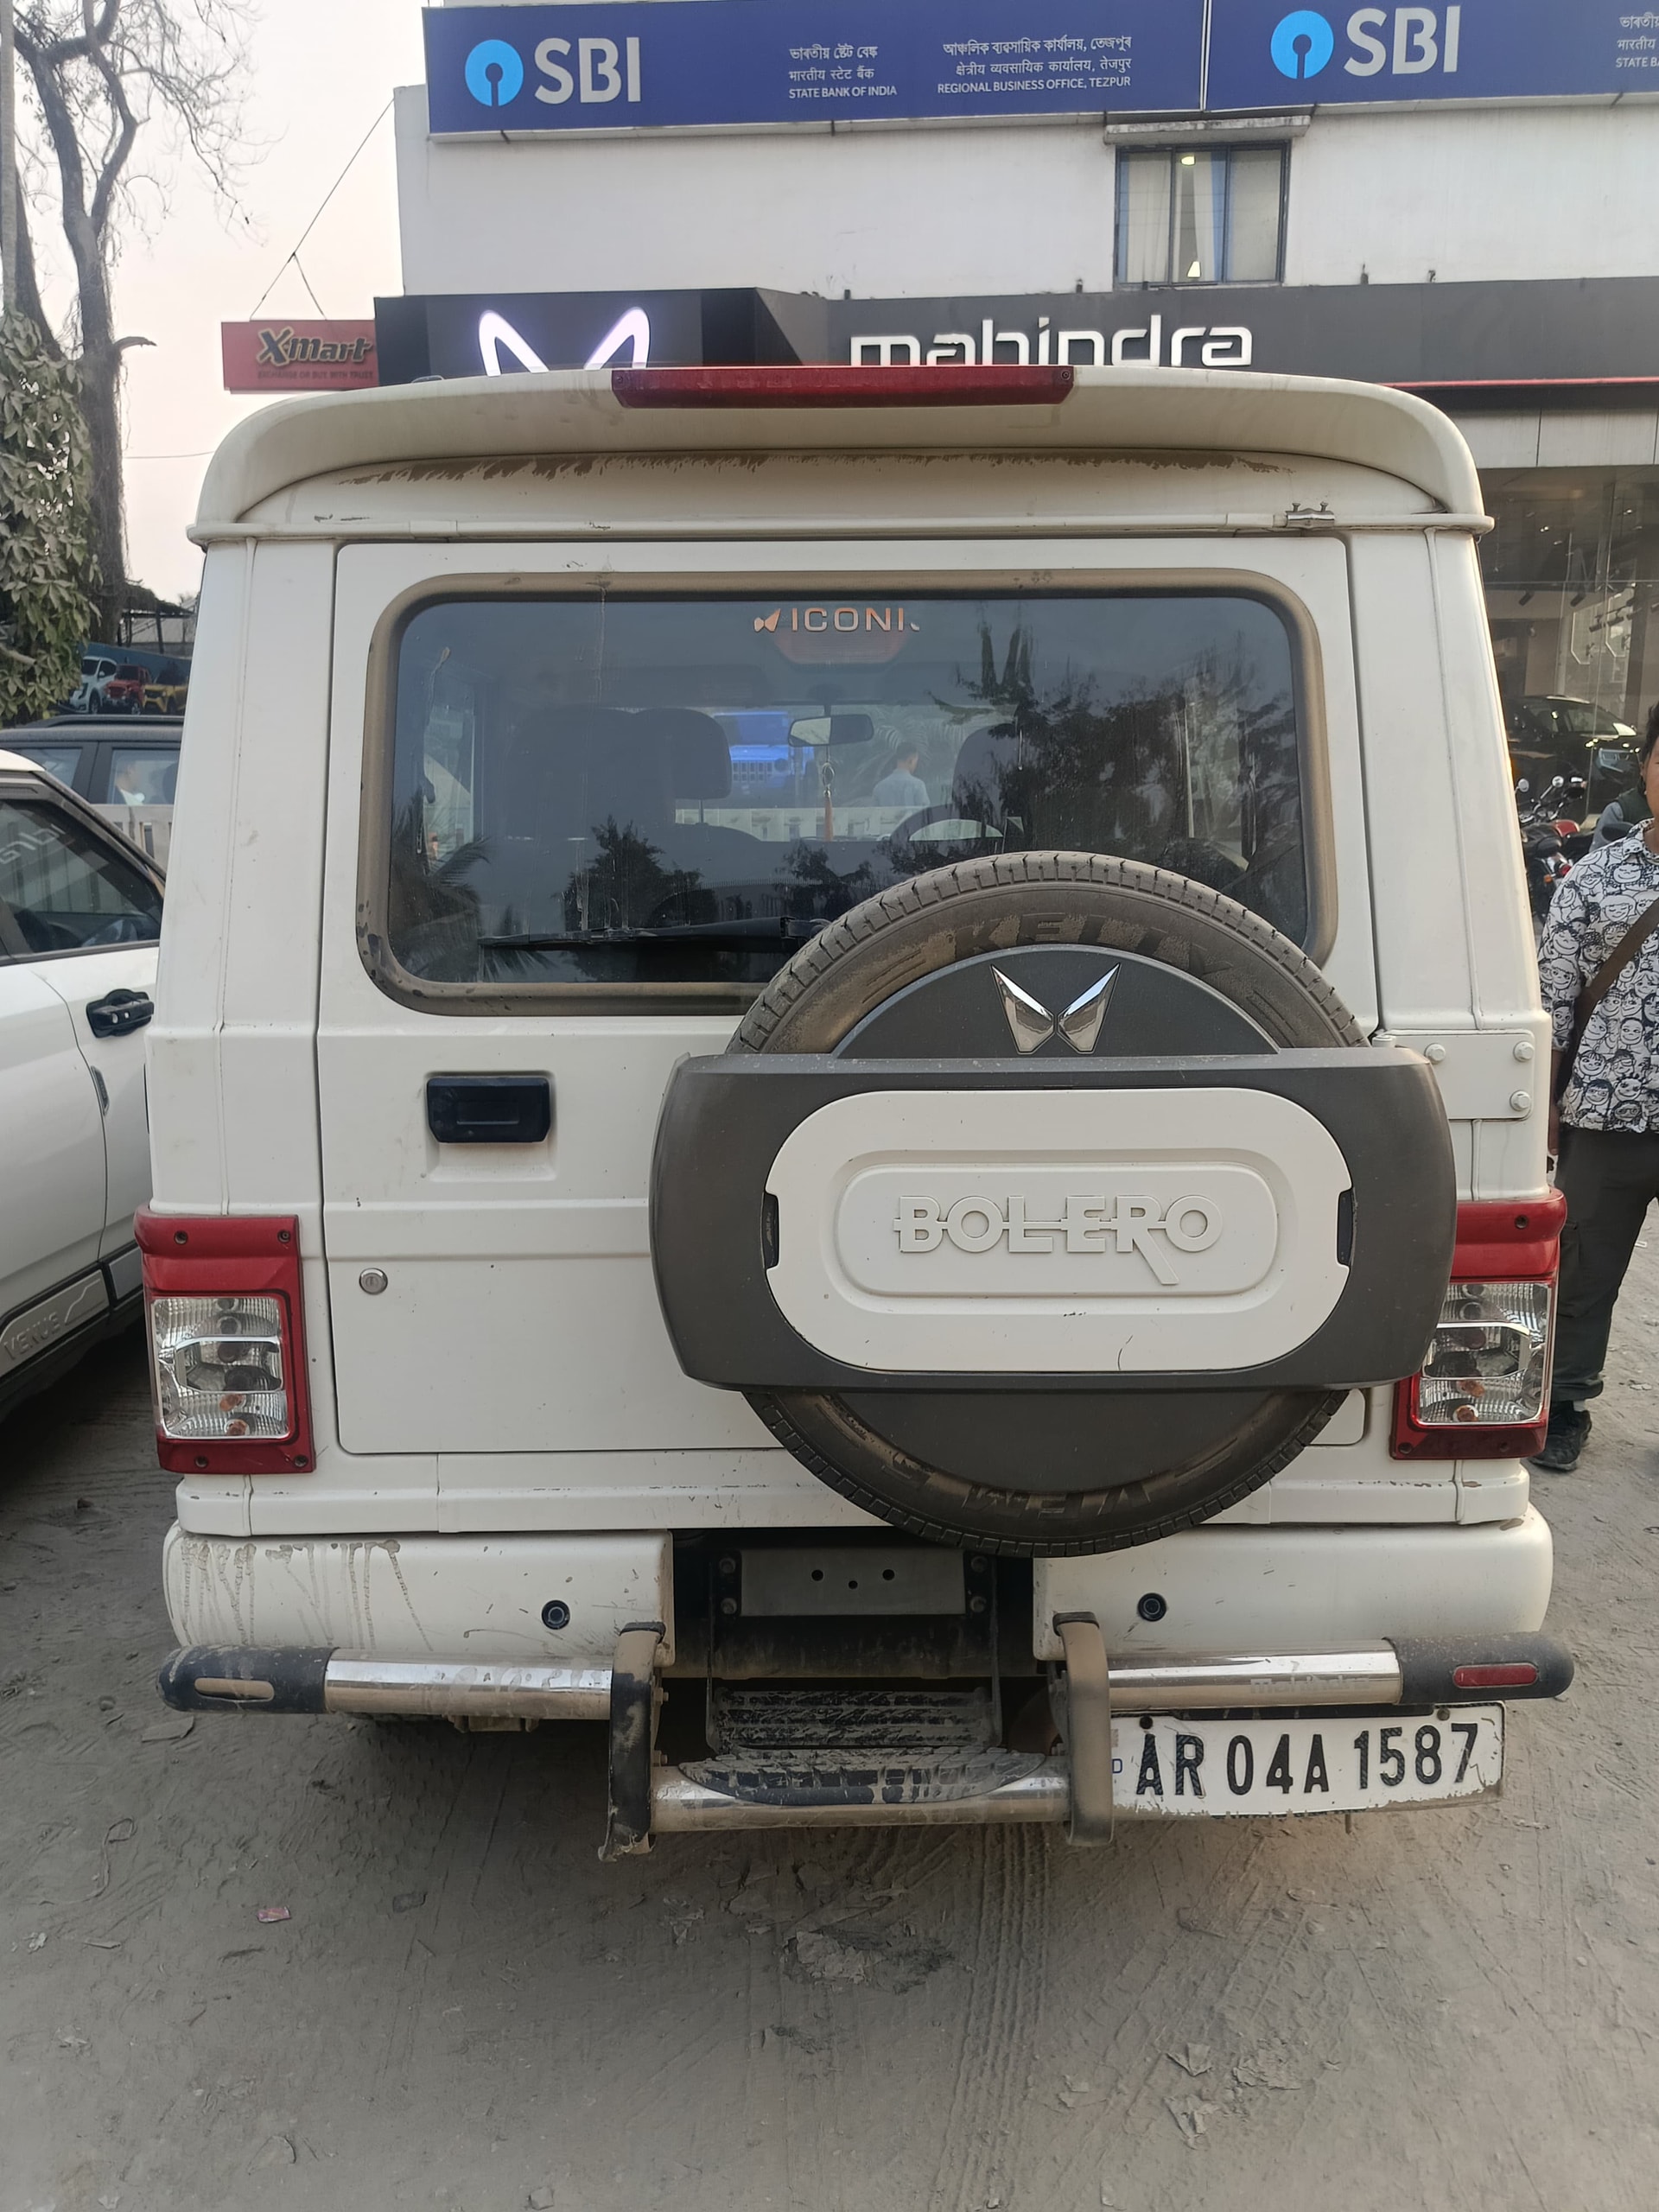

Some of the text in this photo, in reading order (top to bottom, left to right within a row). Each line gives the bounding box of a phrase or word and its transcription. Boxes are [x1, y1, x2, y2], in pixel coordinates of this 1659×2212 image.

[1344, 5, 1461, 77] SBI
[1617, 35, 1656, 50] भारतीय
[534, 36, 641, 105] SBI
[788, 65, 874, 81] भारतीय स्टेट बैंक
[956, 61, 986, 75] क्षेत्रीय
[1099, 55, 1132, 73] तेजपुर
[1616, 57, 1649, 68] STATE
[789, 86, 898, 99] STATE BANK OF INDIA
[938, 76, 1131, 93] REGIONAL BUSINESS OFFICE, TEZPUR
[256, 326, 374, 366] Xmart
[850, 314, 1253, 367] mahindra
[790, 607, 920, 632] ICONI
[893, 1194, 1224, 1286] BOLERO
[1135, 1722, 1479, 1797] AR 04A 1587
